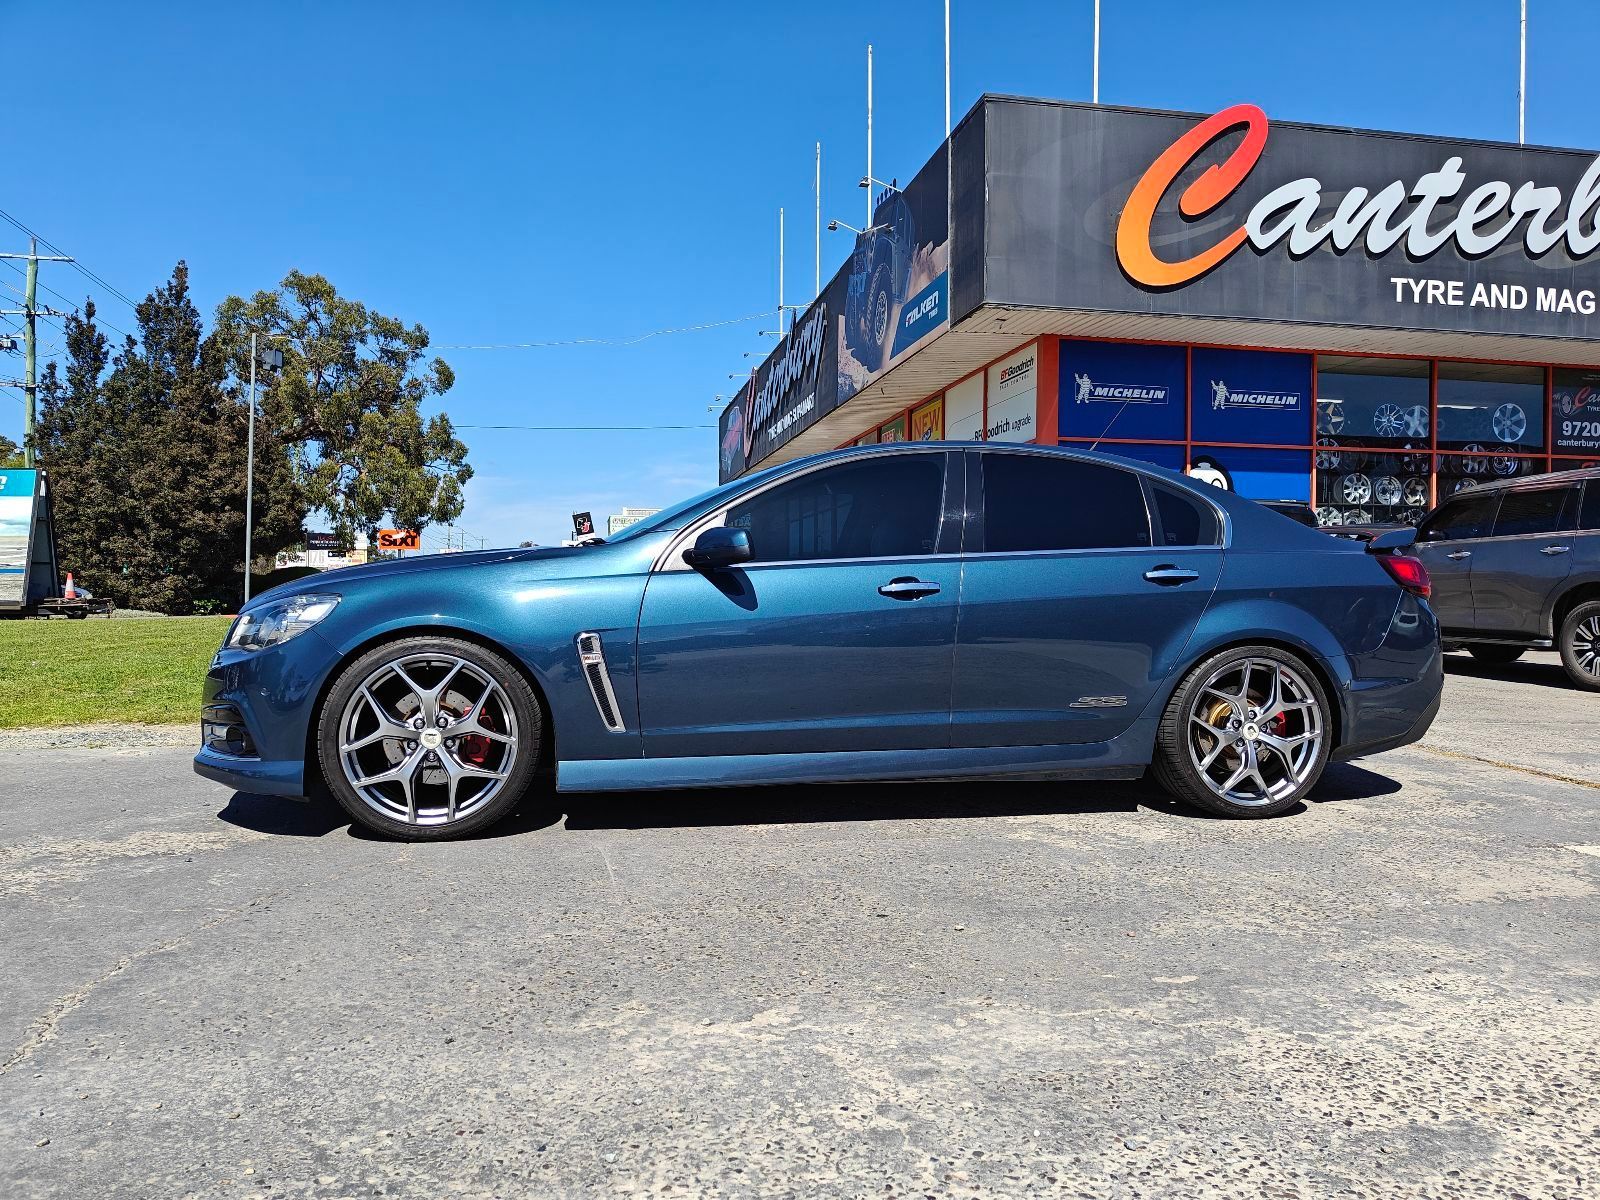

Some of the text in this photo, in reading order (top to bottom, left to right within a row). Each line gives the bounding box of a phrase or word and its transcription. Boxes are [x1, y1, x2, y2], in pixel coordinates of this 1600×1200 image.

[1391, 277, 1596, 315] TYRE AND MAG
[905, 290, 939, 328] FALKEN
[1094, 387, 1165, 399] MICHELIN
[1229, 393, 1297, 405] MICHELIN
[1011, 413, 1032, 432] upgrade
[1562, 420, 1600, 437] 9720
